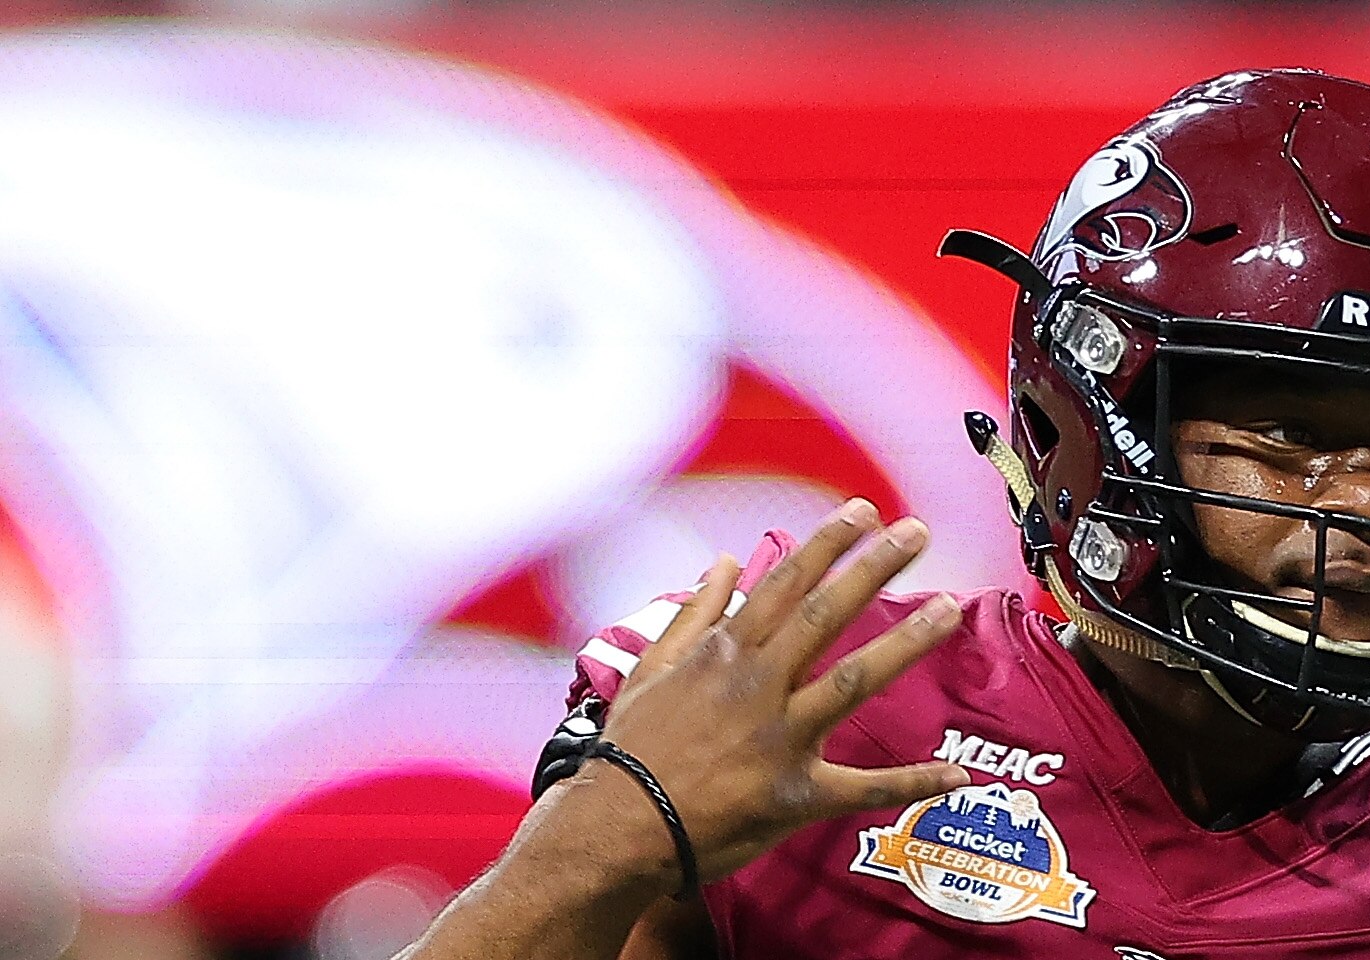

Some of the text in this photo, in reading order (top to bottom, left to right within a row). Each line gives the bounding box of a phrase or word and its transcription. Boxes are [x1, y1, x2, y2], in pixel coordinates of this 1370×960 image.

[933, 729, 1064, 786] MEAC
[903, 840, 1052, 892] CELEBRATION
[938, 824, 1028, 863] cricket
[939, 872, 1002, 901] BOWL
